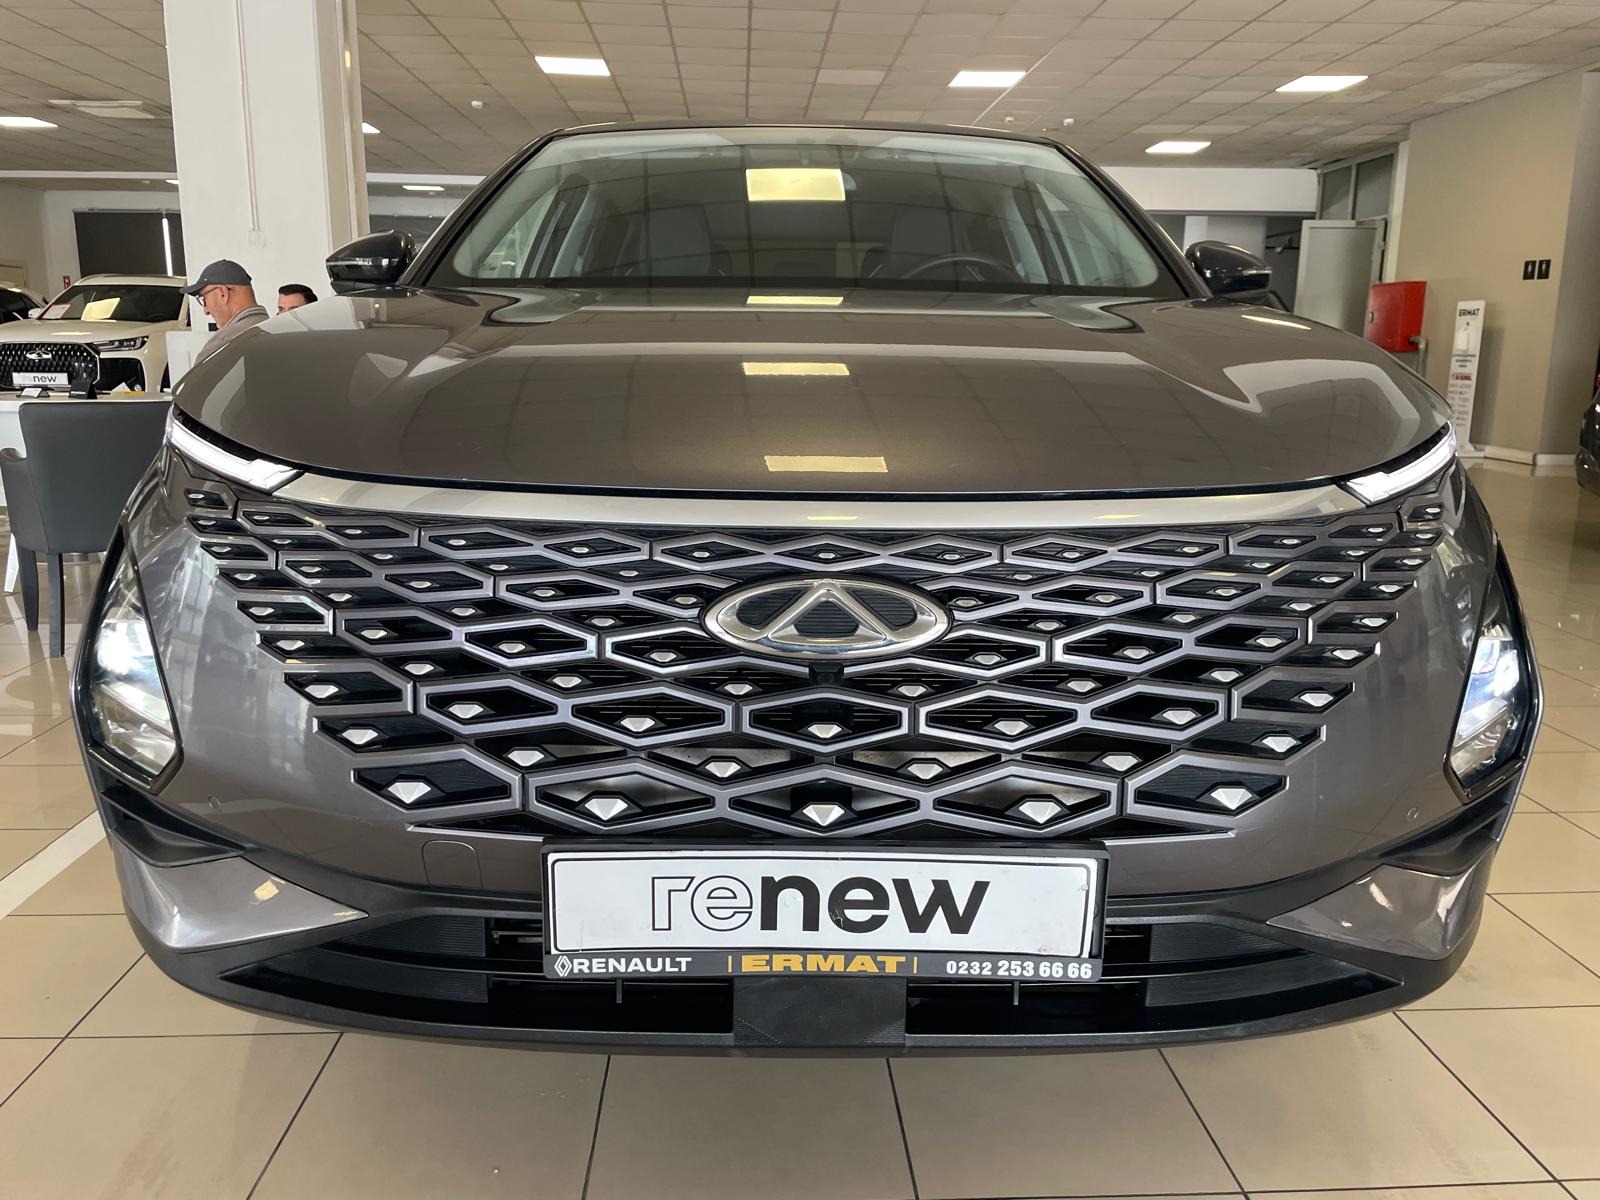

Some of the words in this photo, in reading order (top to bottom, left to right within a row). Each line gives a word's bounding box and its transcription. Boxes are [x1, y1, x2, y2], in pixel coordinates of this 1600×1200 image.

[651, 875, 991, 935] renew
[573, 957, 692, 973] RENAULT
[741, 954, 906, 973] ERMAT
[946, 960, 992, 976] 0232
[997, 959, 1035, 977] 253
[1039, 961, 1065, 978] 66
[1067, 962, 1092, 979] 66
